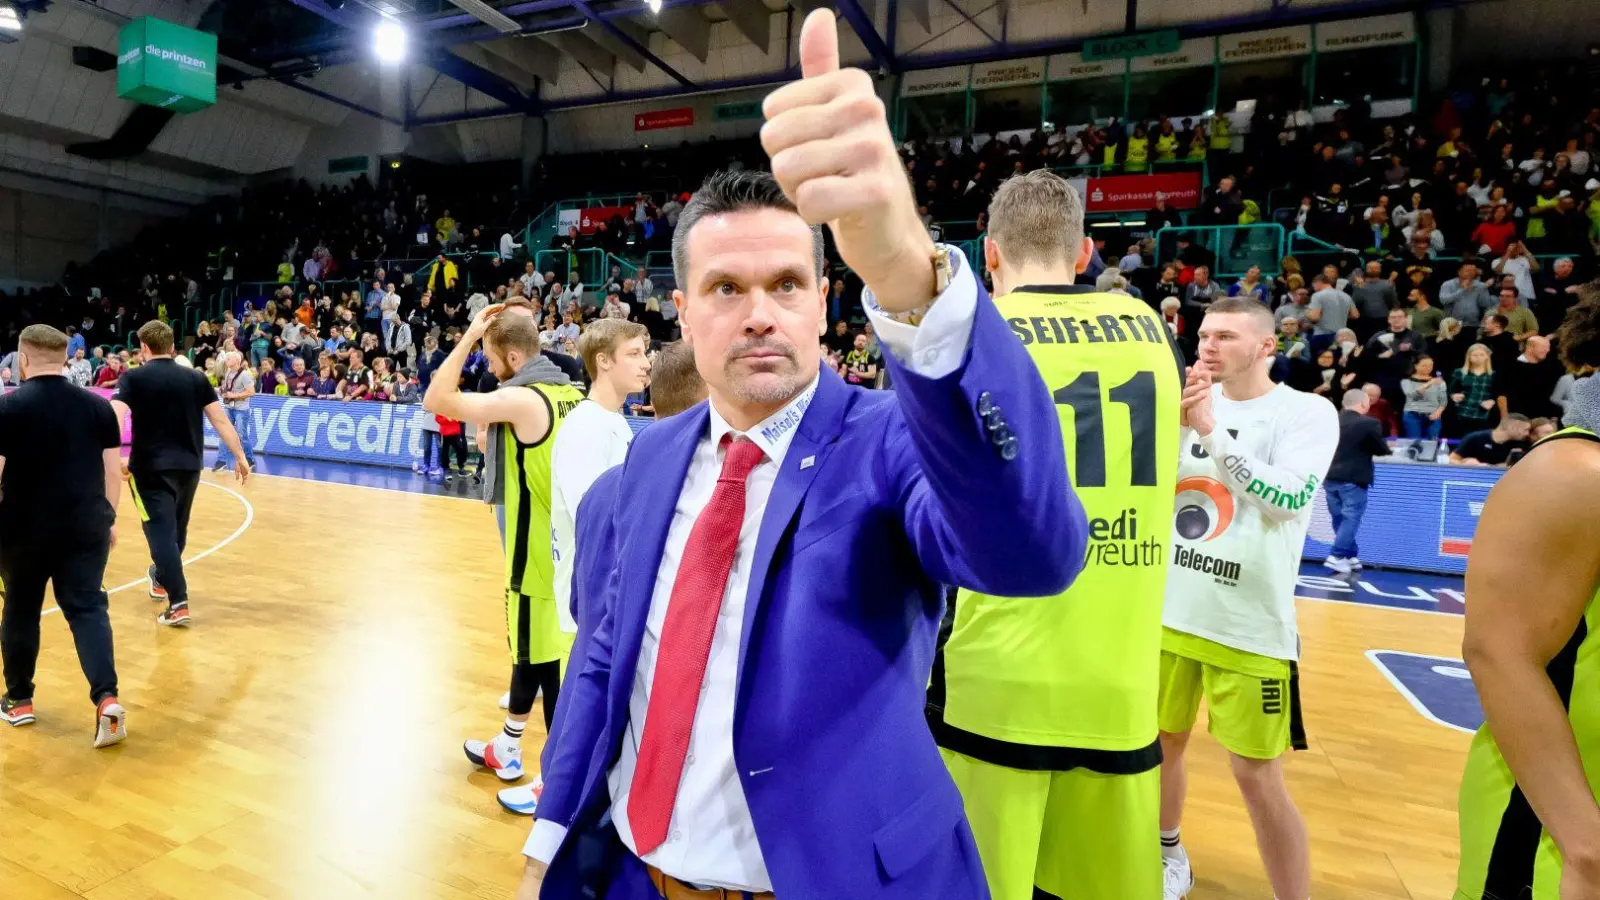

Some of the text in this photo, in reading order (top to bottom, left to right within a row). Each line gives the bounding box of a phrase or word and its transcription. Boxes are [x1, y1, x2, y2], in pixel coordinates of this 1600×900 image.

[161, 49, 206, 69] printzen
[1091, 38, 1147, 56] BLOCK
[1107, 191, 1154, 203] Sparkasse
[1007, 314, 1163, 346] SEIFERTH
[247, 398, 425, 458] yCredit
[1053, 371, 1157, 488] 11
[1223, 453, 1253, 484] die
[1088, 508, 1137, 541] edi
[1081, 535, 1162, 576] yreuth
[1173, 543, 1242, 581] Telecom
